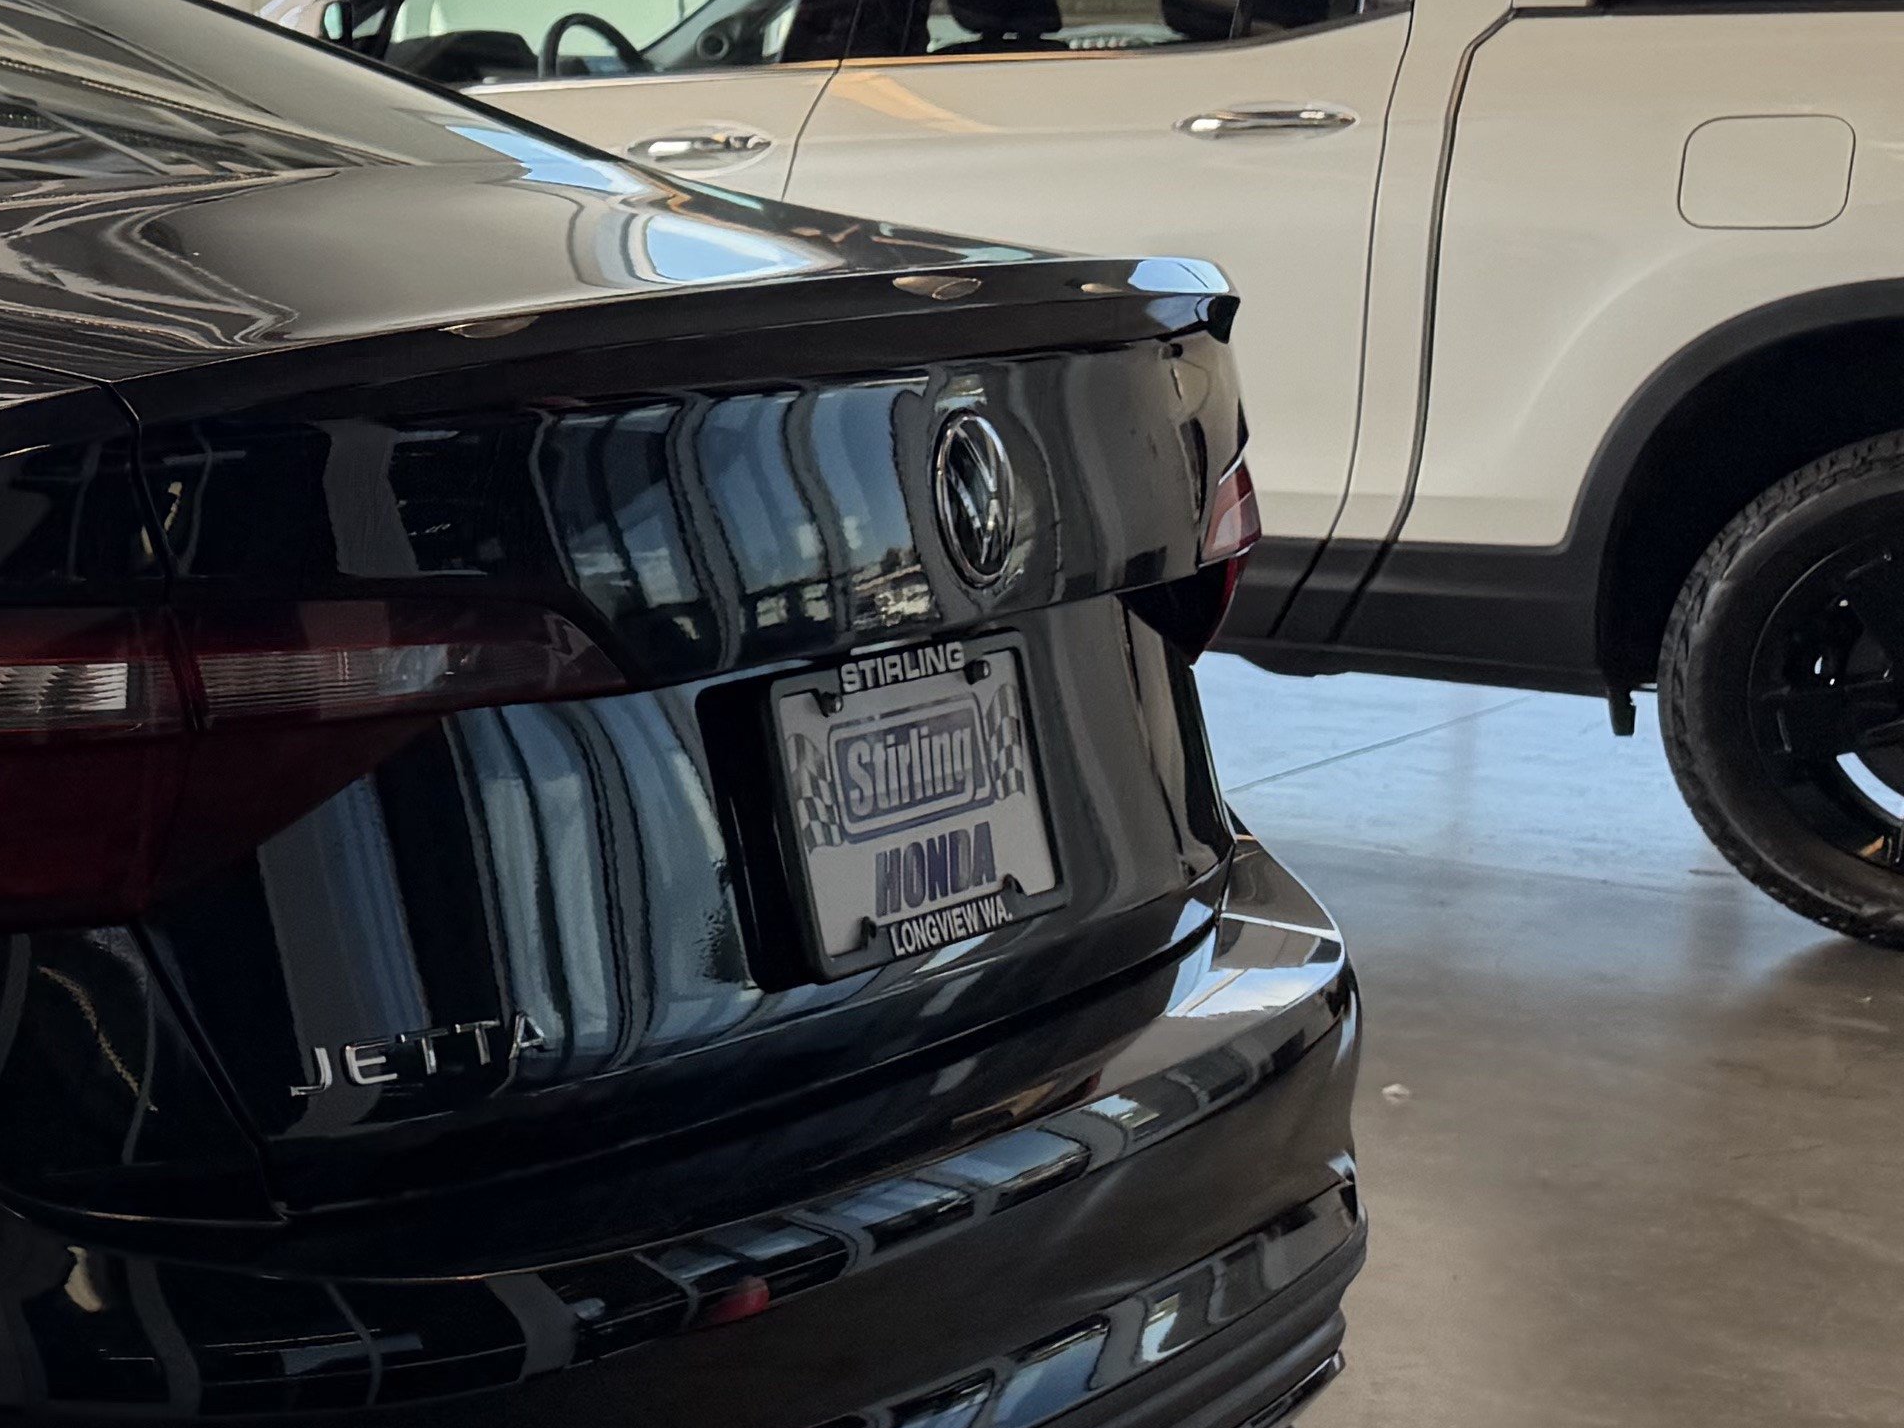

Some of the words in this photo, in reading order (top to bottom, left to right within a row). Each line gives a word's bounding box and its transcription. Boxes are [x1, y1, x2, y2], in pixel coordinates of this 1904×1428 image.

[841, 642, 965, 691] STIRLING
[847, 724, 973, 818] Stirling
[874, 821, 997, 918] HONDA
[891, 911, 980, 956] LONGVIEW
[291, 1012, 546, 1096] JETTA
